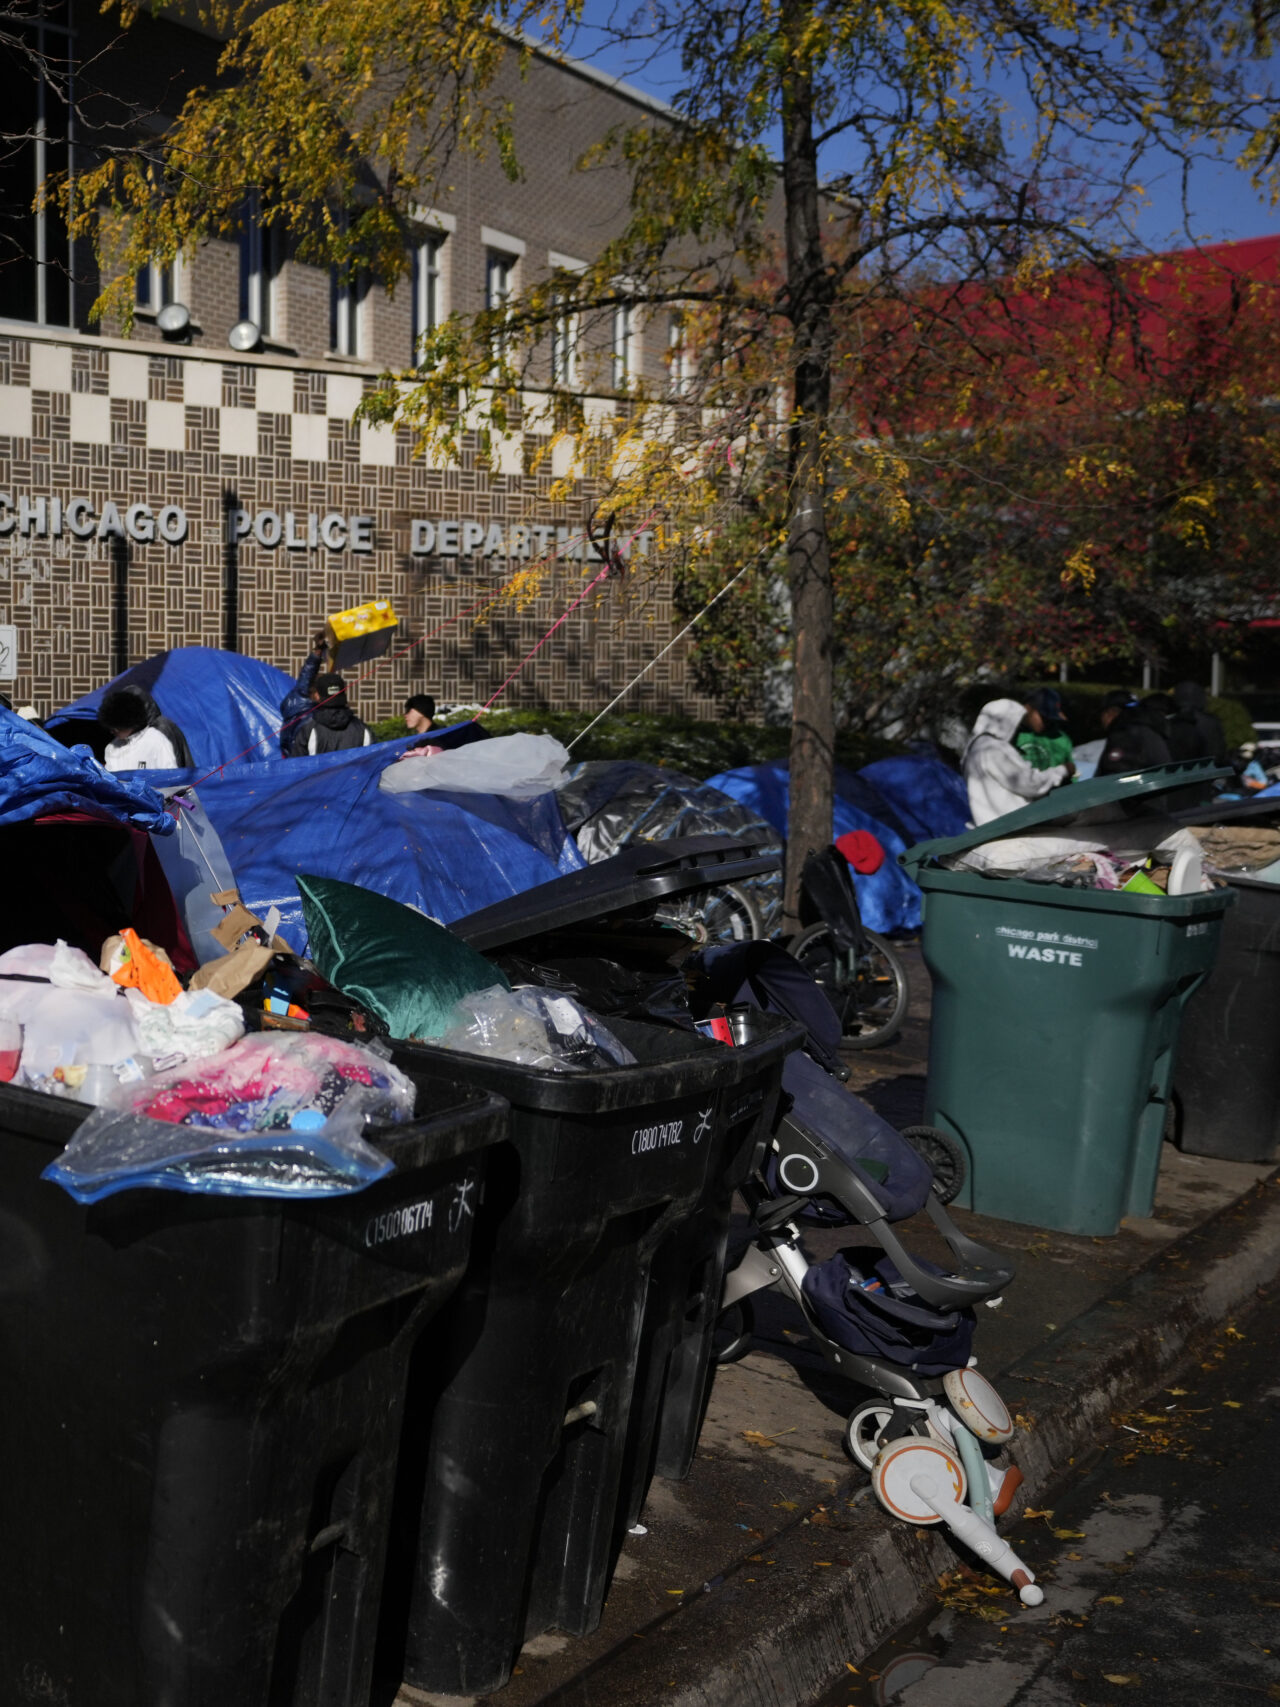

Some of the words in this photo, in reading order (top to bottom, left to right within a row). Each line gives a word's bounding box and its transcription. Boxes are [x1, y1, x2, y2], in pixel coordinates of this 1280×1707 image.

[228, 508, 373, 551] POLICE
[995, 927, 1035, 940] chicago
[1037, 932, 1059, 942] park
[1007, 943, 1083, 967] WASTE
